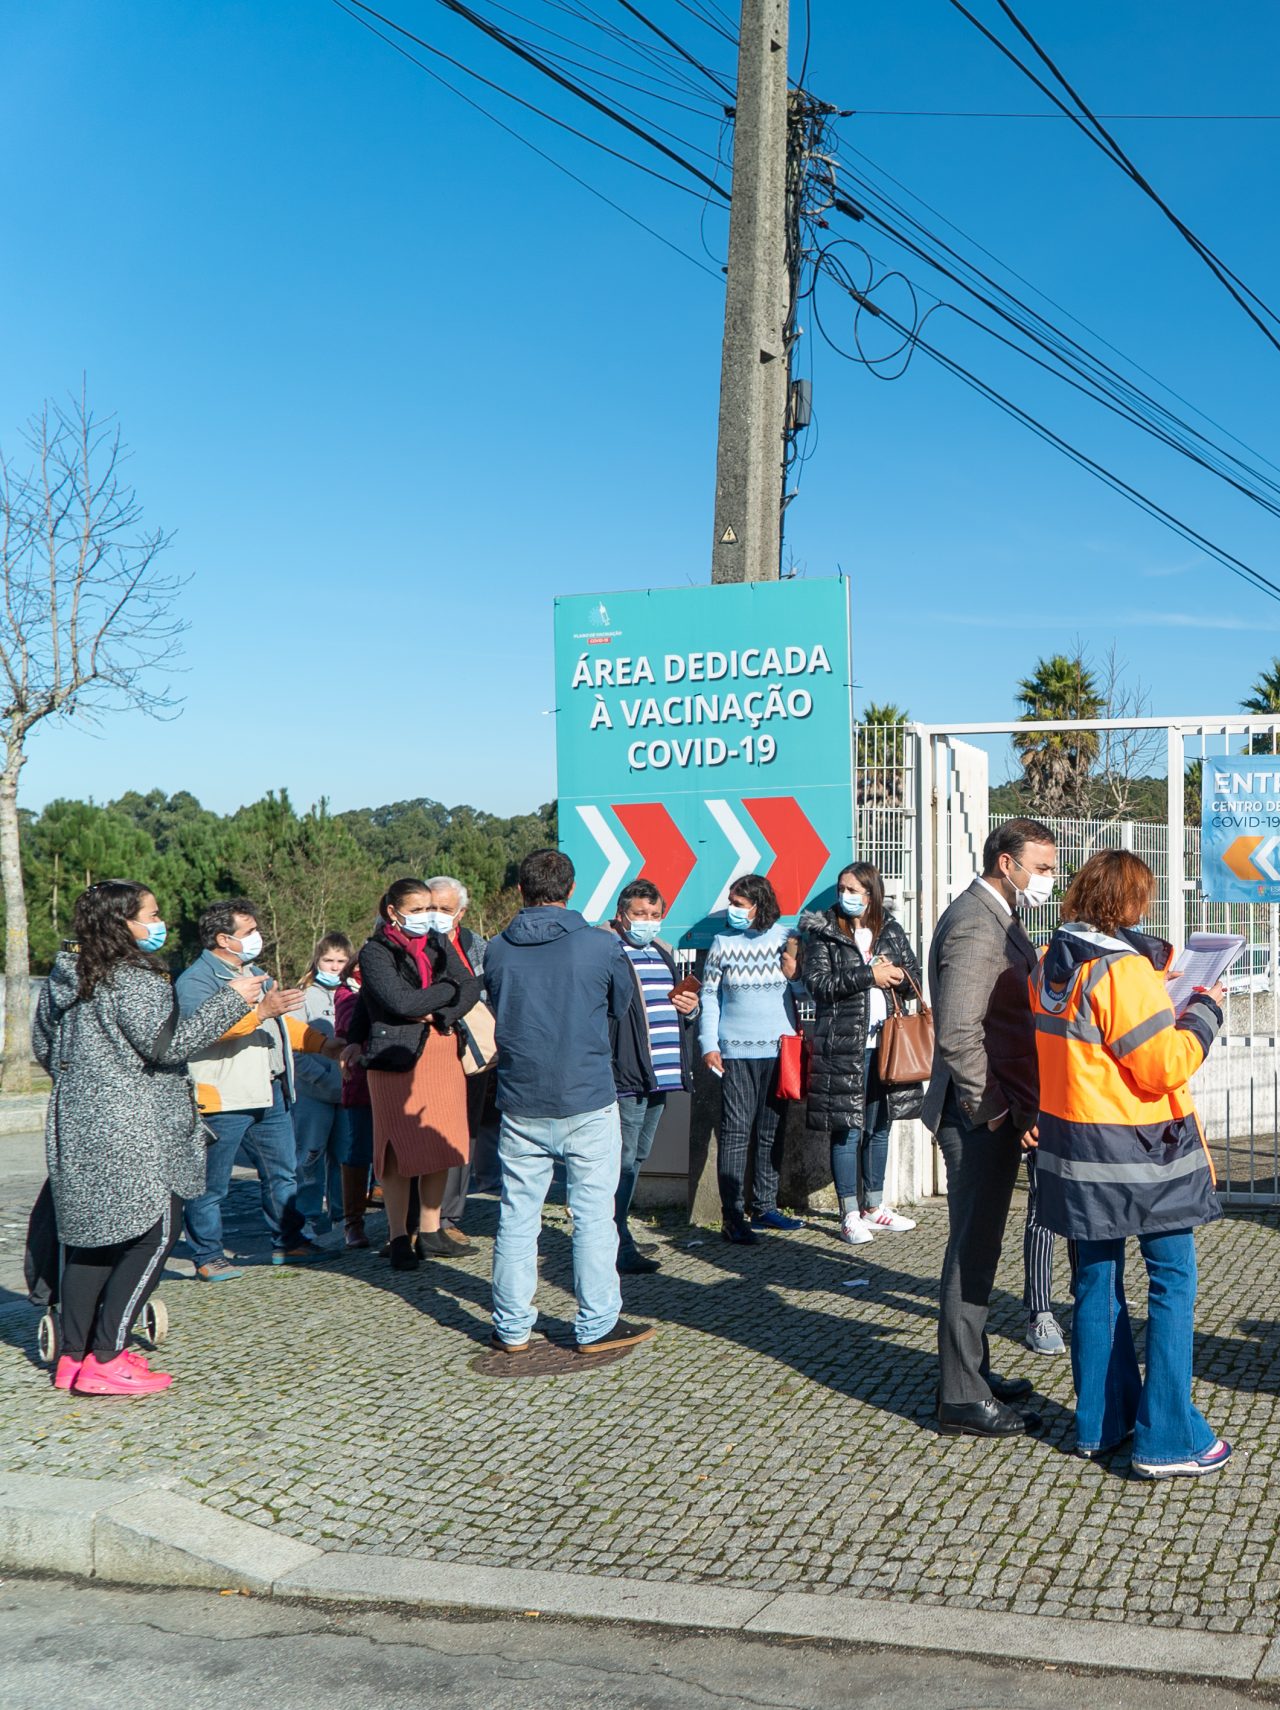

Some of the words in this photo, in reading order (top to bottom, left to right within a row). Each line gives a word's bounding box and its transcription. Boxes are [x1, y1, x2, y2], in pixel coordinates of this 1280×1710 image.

[571, 652, 655, 688] ÁREA
[664, 645, 832, 683] DEDICADA
[590, 694, 613, 729] À
[620, 684, 813, 728] VACINAÇÃO
[627, 734, 777, 769] COVID-19
[1212, 801, 1262, 812] CENTRO
[1212, 816, 1280, 828] COVID-19
